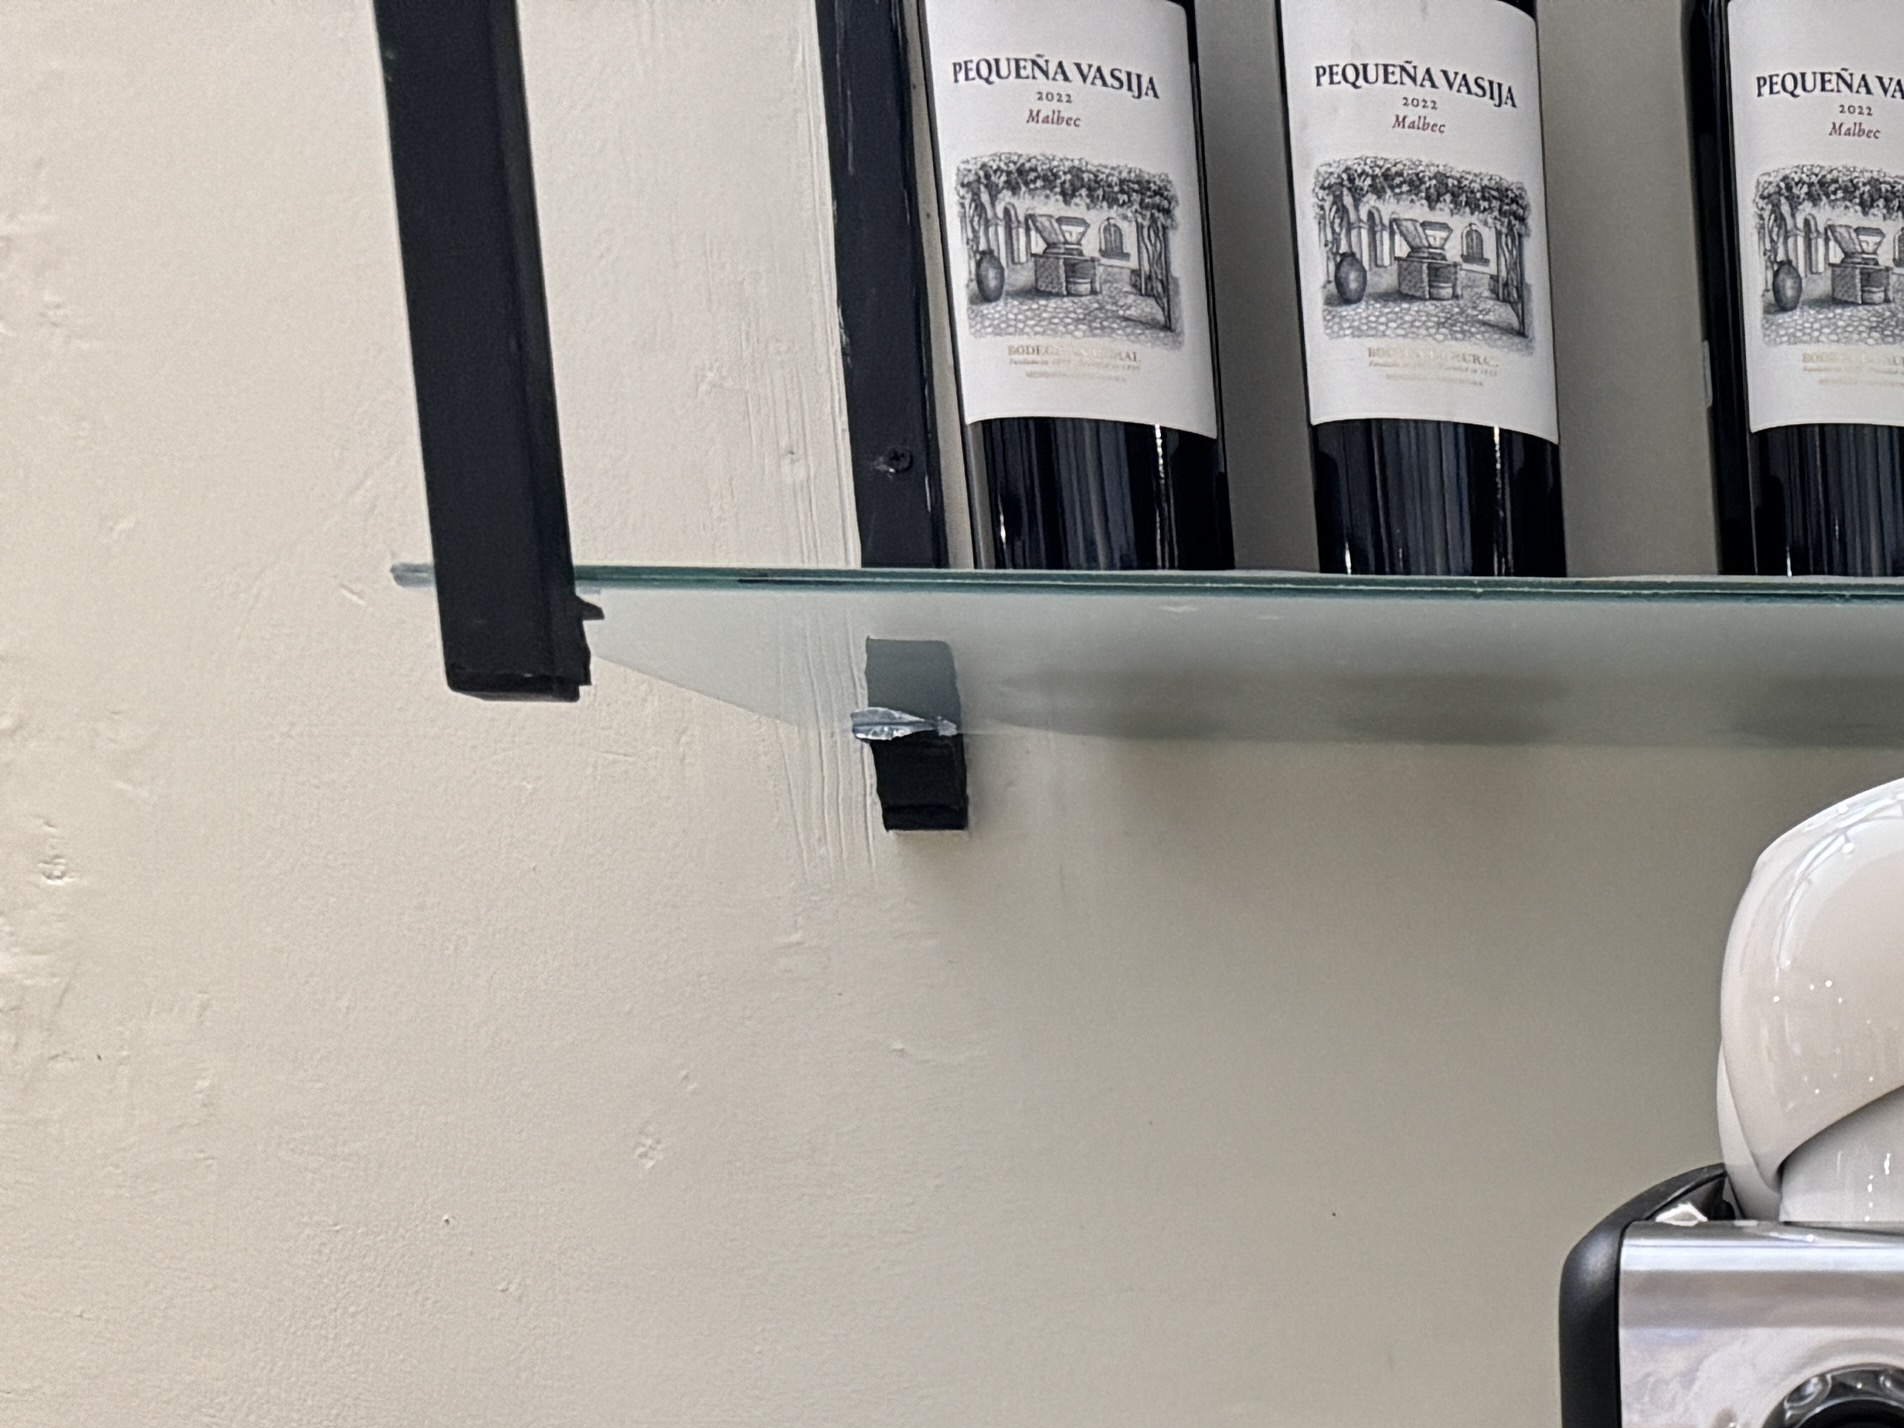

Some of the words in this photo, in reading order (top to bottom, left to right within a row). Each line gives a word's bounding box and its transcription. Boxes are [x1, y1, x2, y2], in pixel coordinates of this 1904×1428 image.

[952, 54, 1072, 85] PEQUEÑA
[1073, 62, 1160, 99] VASIJA
[1315, 60, 1439, 89] PEQUEÑA
[1440, 69, 1517, 108] VASIJA
[1756, 68, 1873, 98] PEQUEÑA
[1037, 91, 1073, 103] 2022
[1402, 97, 1438, 110] 2022
[1026, 109, 1082, 128] Malbec
[1839, 104, 1873, 116] 2022
[1392, 114, 1446, 134] Malbec
[1828, 122, 1881, 139] Malbec
